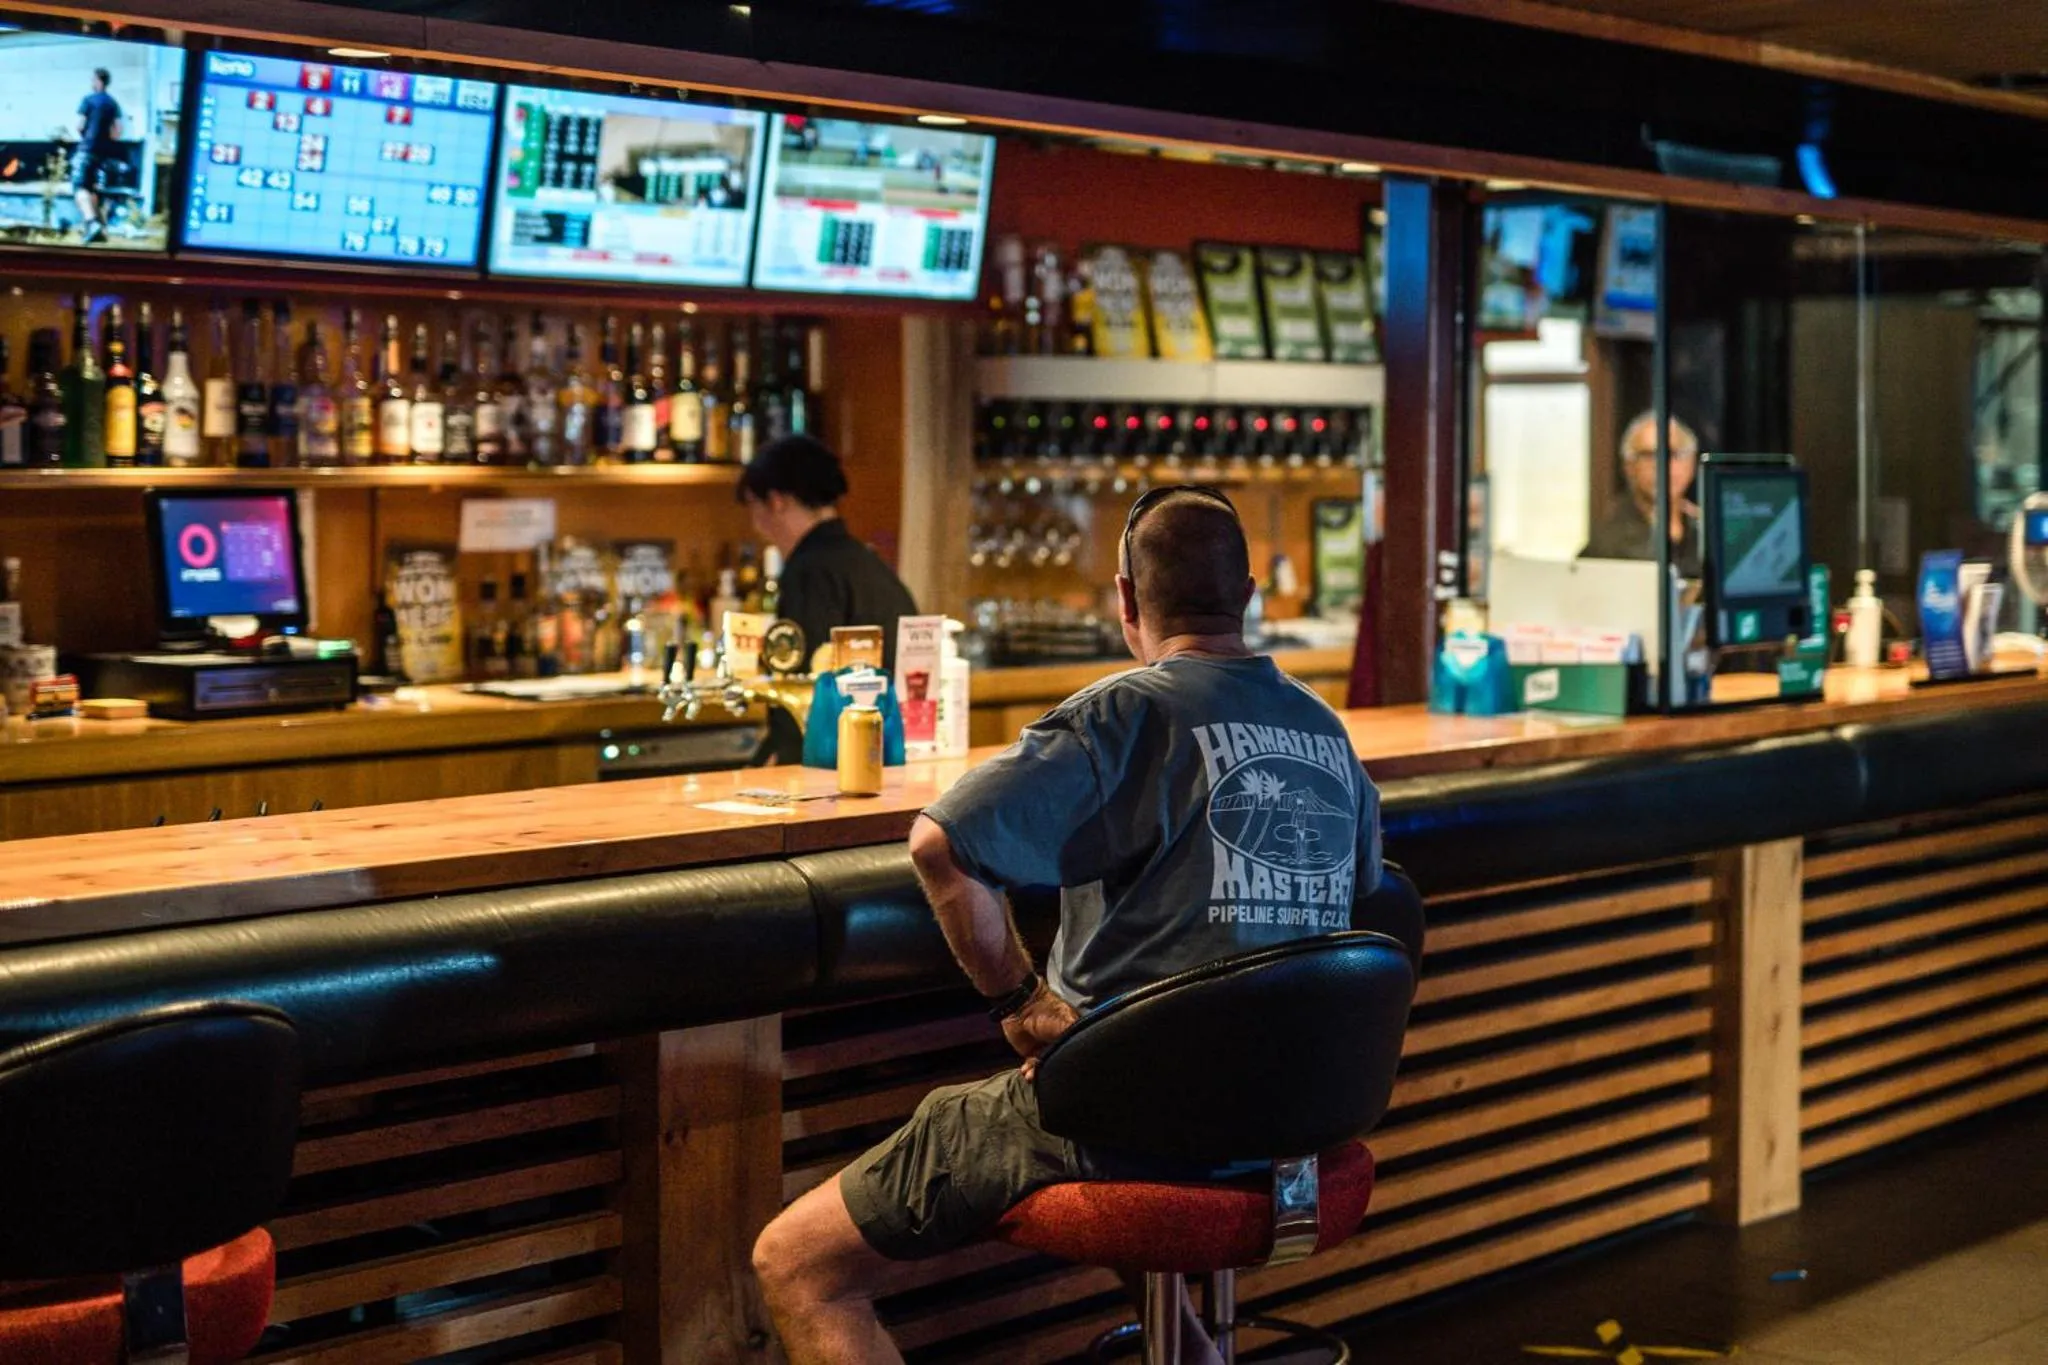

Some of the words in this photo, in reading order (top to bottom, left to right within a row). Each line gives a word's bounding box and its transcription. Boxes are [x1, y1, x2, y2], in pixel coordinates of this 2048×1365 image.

[238, 168, 264, 187] 42
[205, 203, 229, 222] 61
[908, 628, 934, 641] WIN
[1191, 722, 1355, 797] HAWAIIAN
[1208, 905, 1274, 924] PIPELINE
